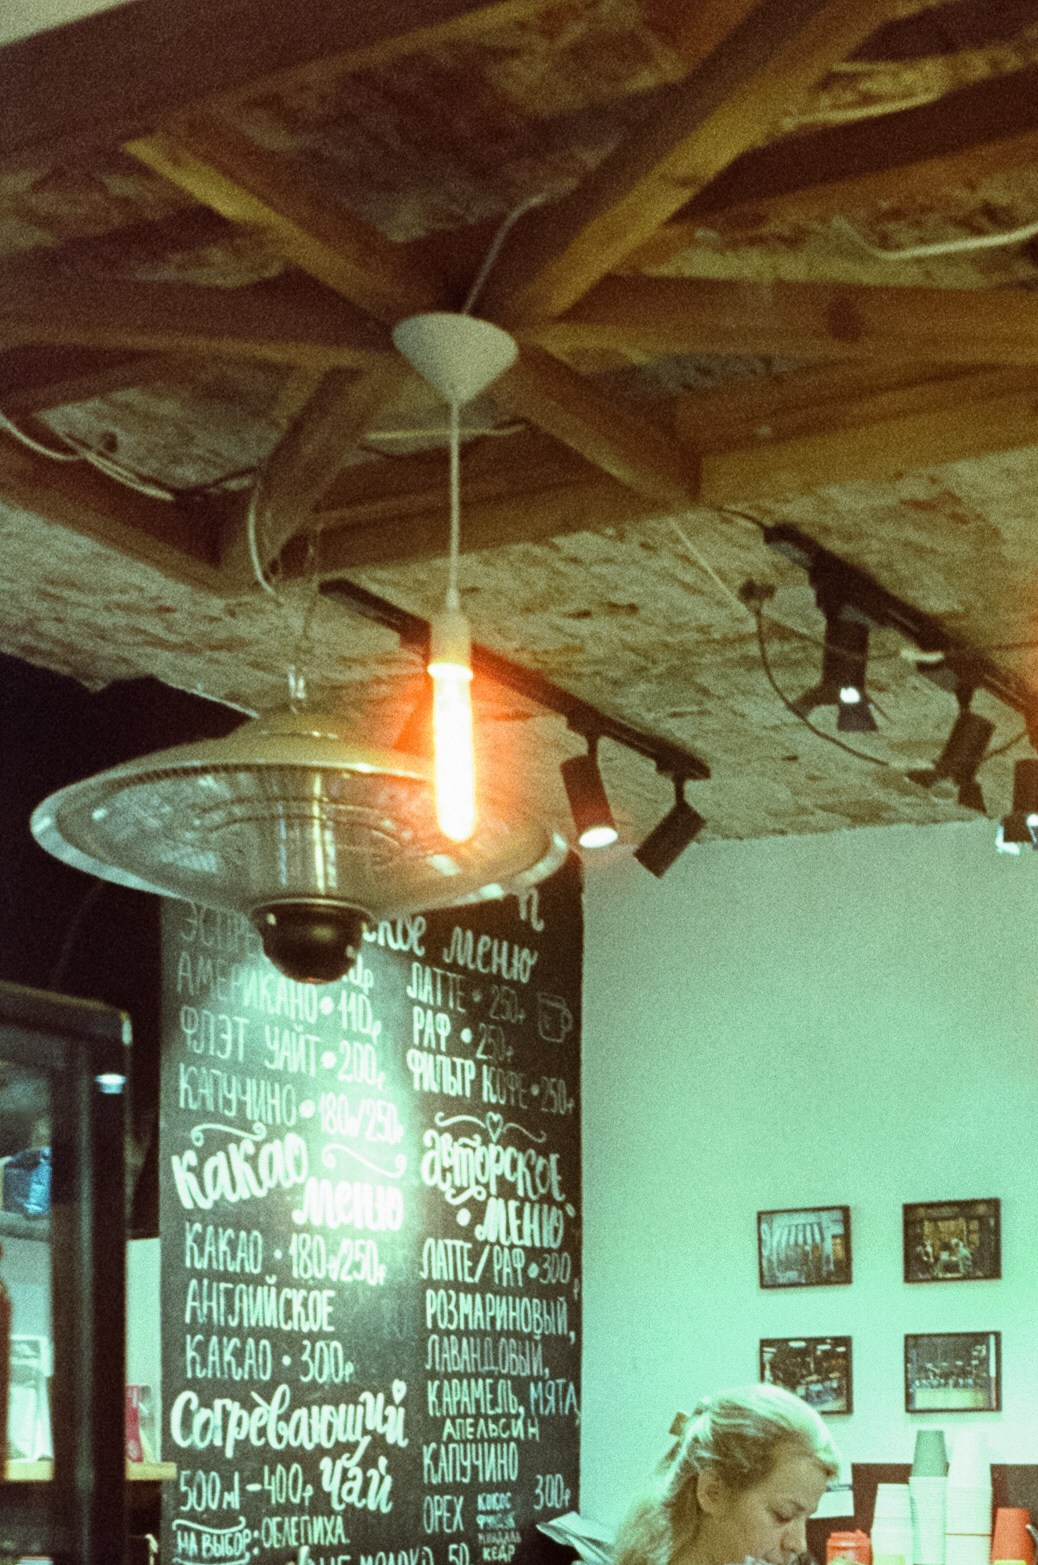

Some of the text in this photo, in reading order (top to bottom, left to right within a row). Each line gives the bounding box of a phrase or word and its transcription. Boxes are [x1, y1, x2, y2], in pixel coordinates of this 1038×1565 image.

[443, 926, 538, 983] меню
[176, 950, 318, 1025] АМЕРИКАНО
[406, 961, 467, 1013] ЛАТТЕ
[179, 1005, 249, 1062] ФЛЭТ
[264, 1023, 321, 1077] УАЙТ
[412, 1006, 451, 1052] РАФ
[178, 1063, 297, 1128] КАПУЧИНО
[406, 1049, 477, 1098] ФИЛЬТР
[185, 1222, 262, 1274] КАКАО
[185, 1275, 336, 1333] АНГЛИЙСКОЕ
[186, 1334, 272, 1381] КАКАО
[170, 1379, 409, 1458] Согревающий
[443, 1417, 540, 1442] АПЕЛЬСИН
[423, 1442, 519, 1484] КАПУЧИНО
[424, 1495, 464, 1534] ОРЕХ
[176, 1531, 199, 1556] НА
